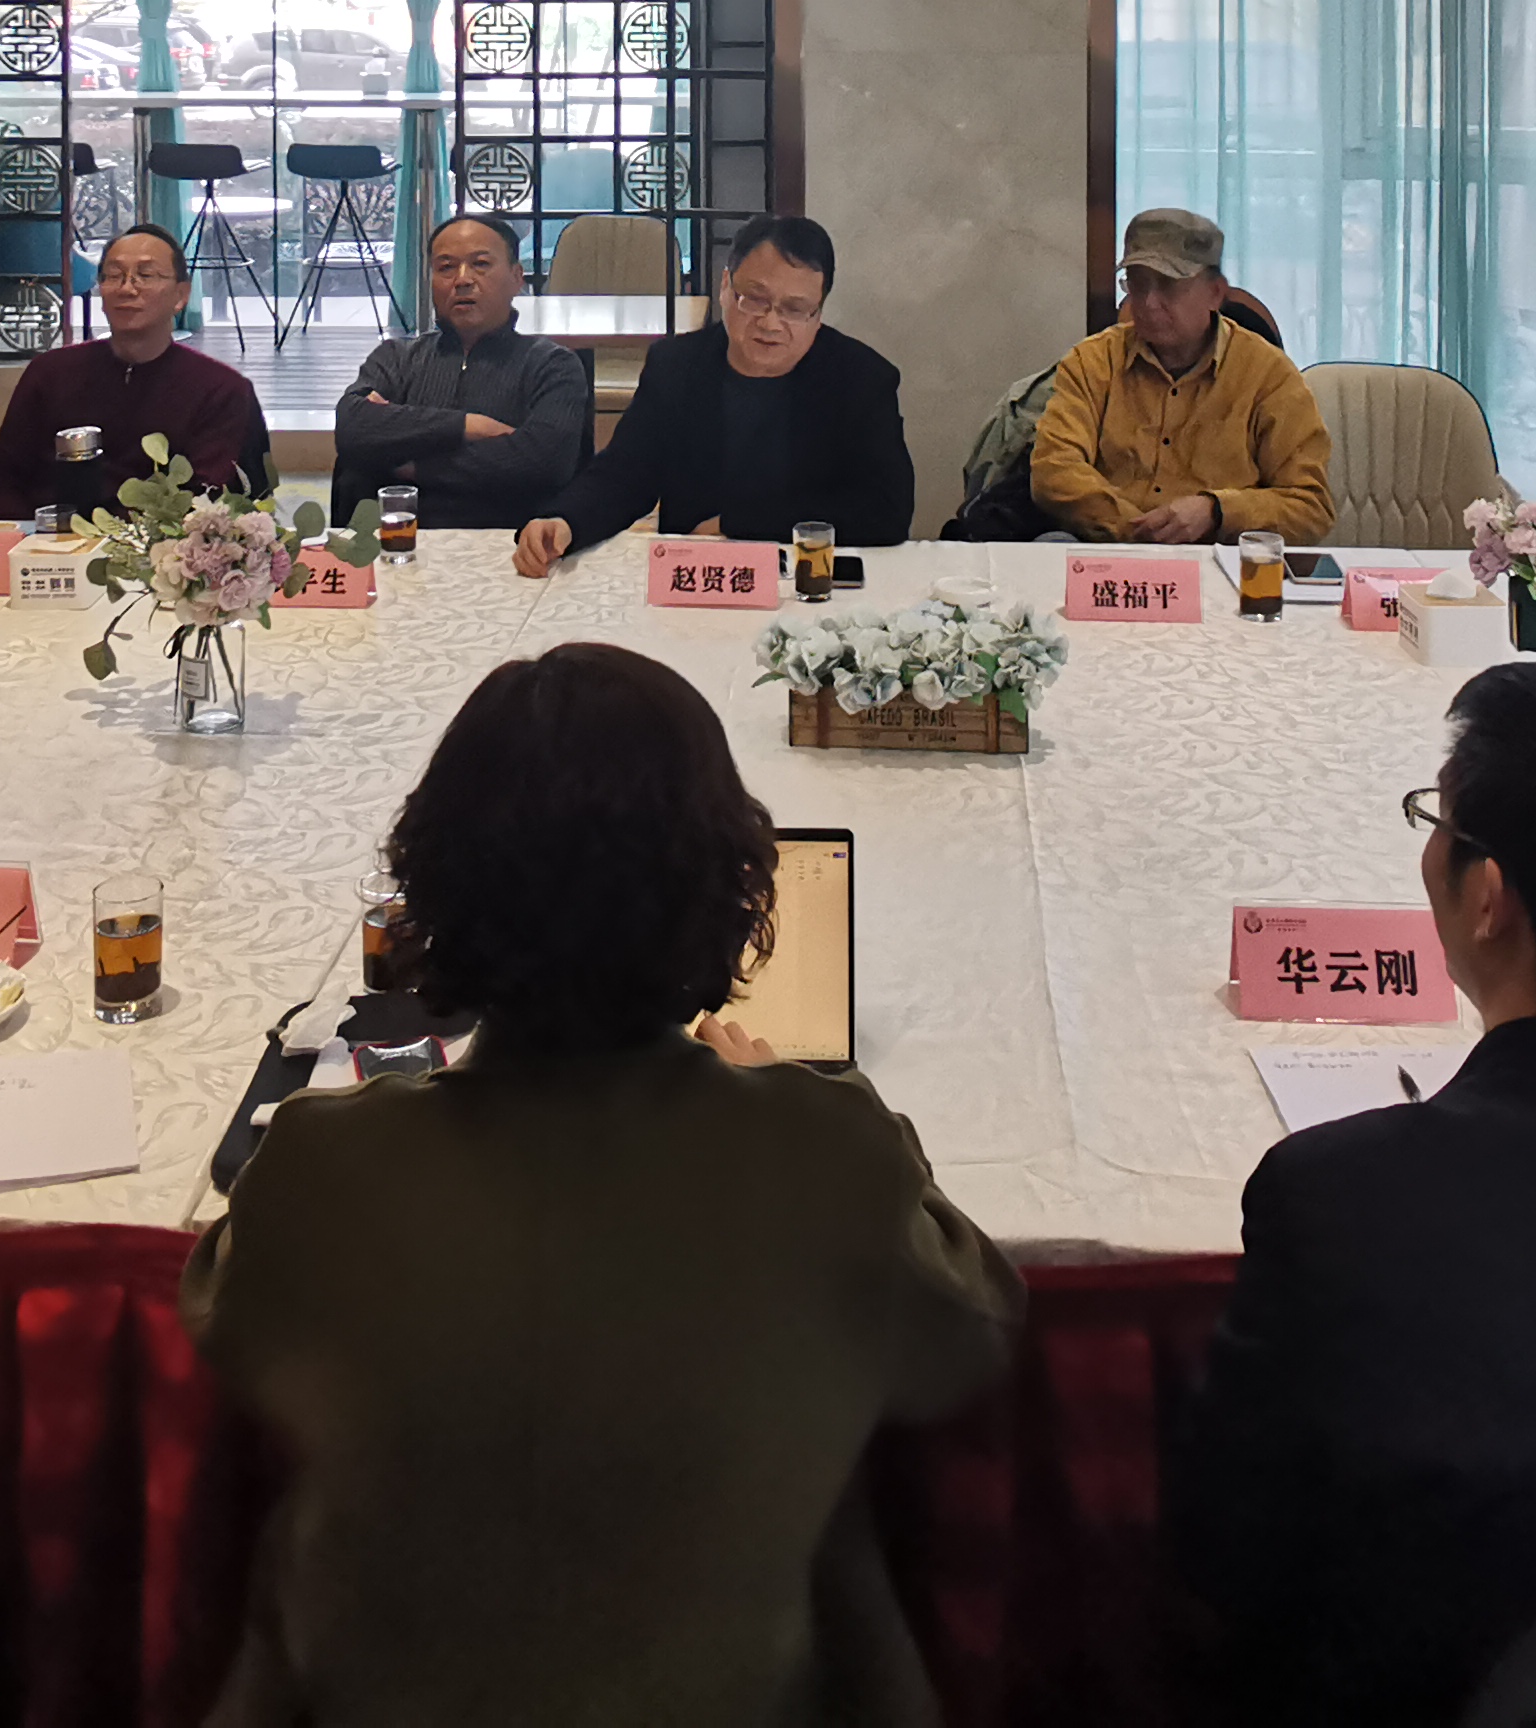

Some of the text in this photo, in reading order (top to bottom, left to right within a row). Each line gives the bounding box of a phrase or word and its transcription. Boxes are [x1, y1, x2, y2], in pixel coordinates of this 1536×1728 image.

[669, 564, 756, 594] 赵贤德
[1091, 579, 1180, 610] 盛福平
[1276, 946, 1418, 997] 华云刚
